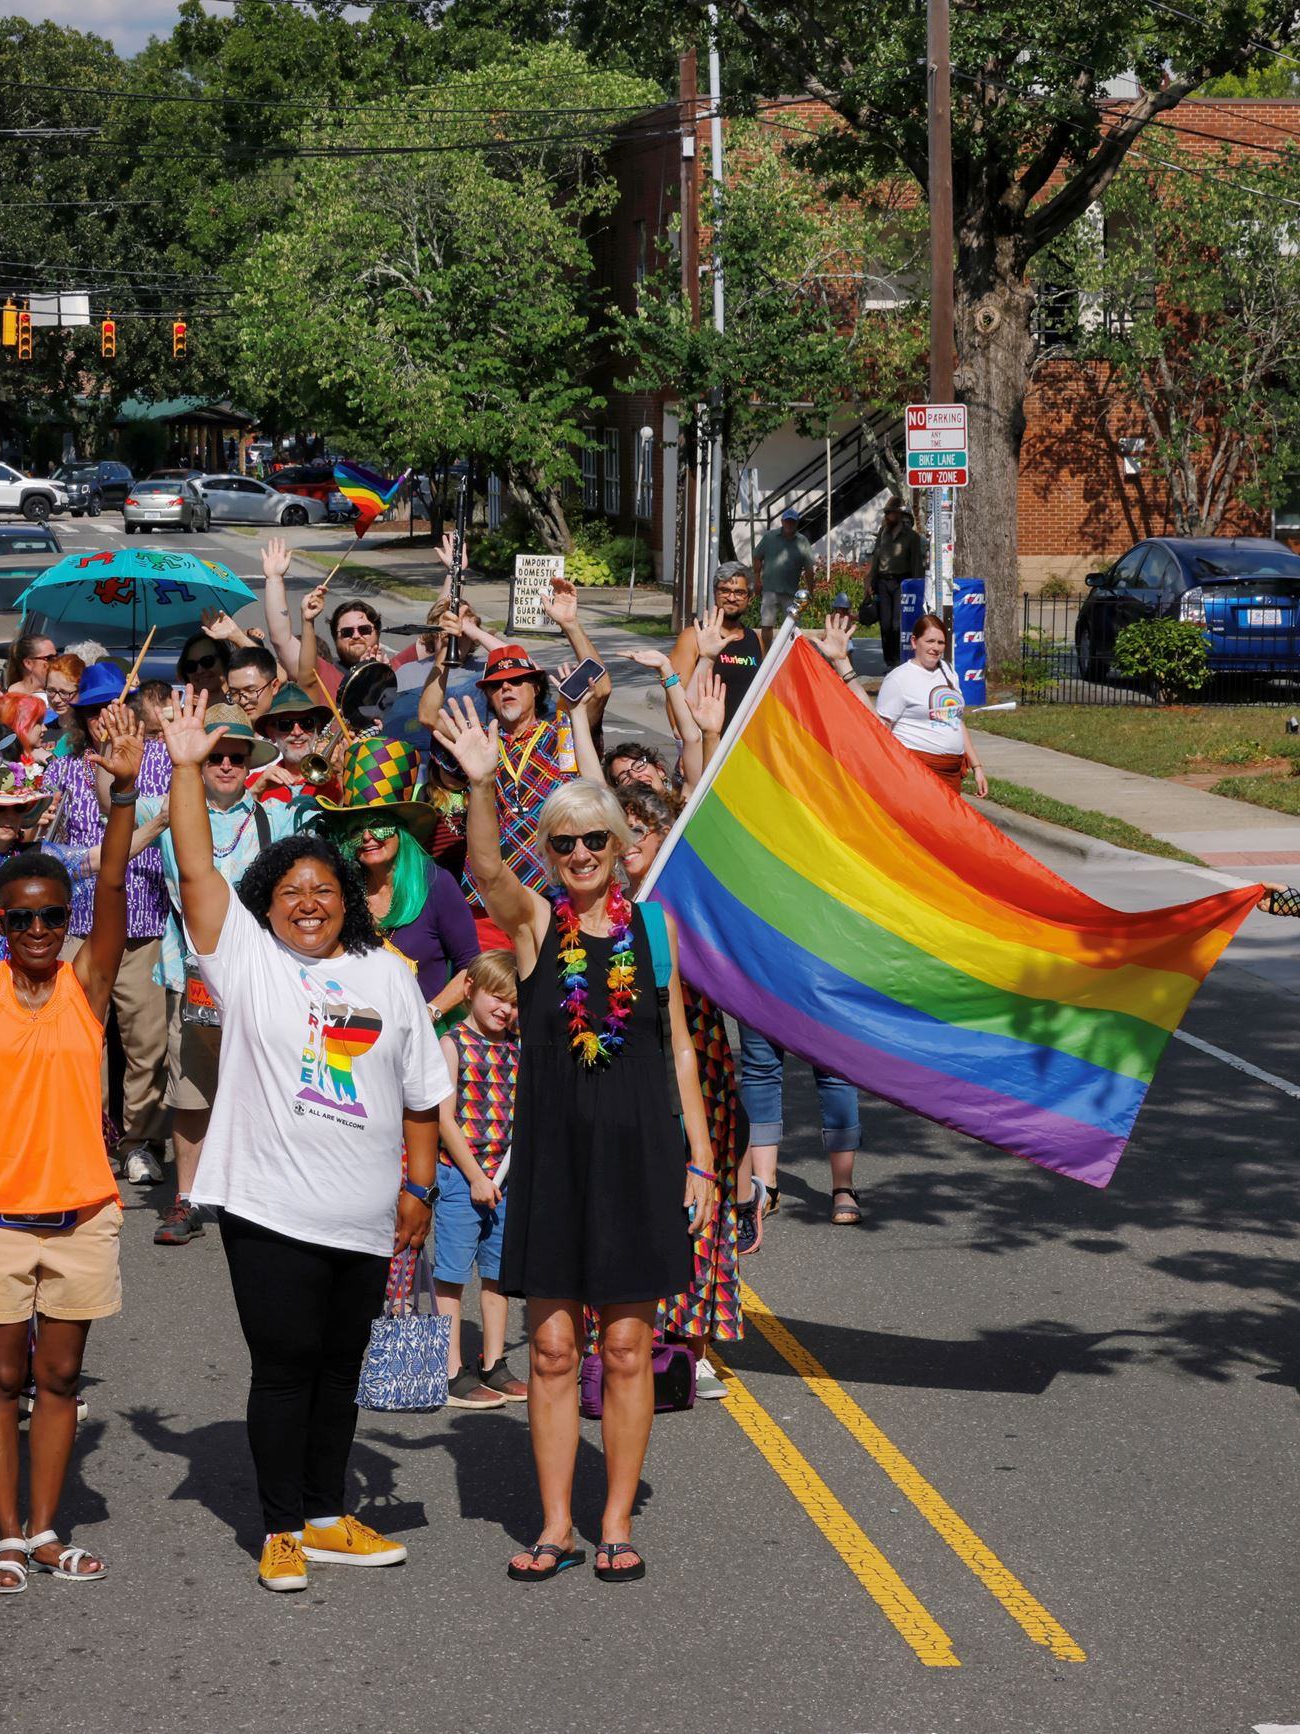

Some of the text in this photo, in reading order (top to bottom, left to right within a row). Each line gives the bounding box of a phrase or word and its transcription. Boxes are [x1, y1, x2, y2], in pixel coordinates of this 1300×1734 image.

[908, 411, 962, 426] NO PARKING
[931, 439, 942, 447] TIME
[918, 454, 956, 466] BIKE LANE
[917, 472, 933, 484] TOW
[522, 558, 550, 567] IMPORT
[518, 568, 557, 577] DOMESTIC
[516, 588, 540, 596] THANK
[514, 597, 533, 605] BEST
[515, 616, 536, 624] SINCE
[720, 654, 748, 666] Hurley
[309, 1108, 365, 1131] ALL ARE WELCOME
